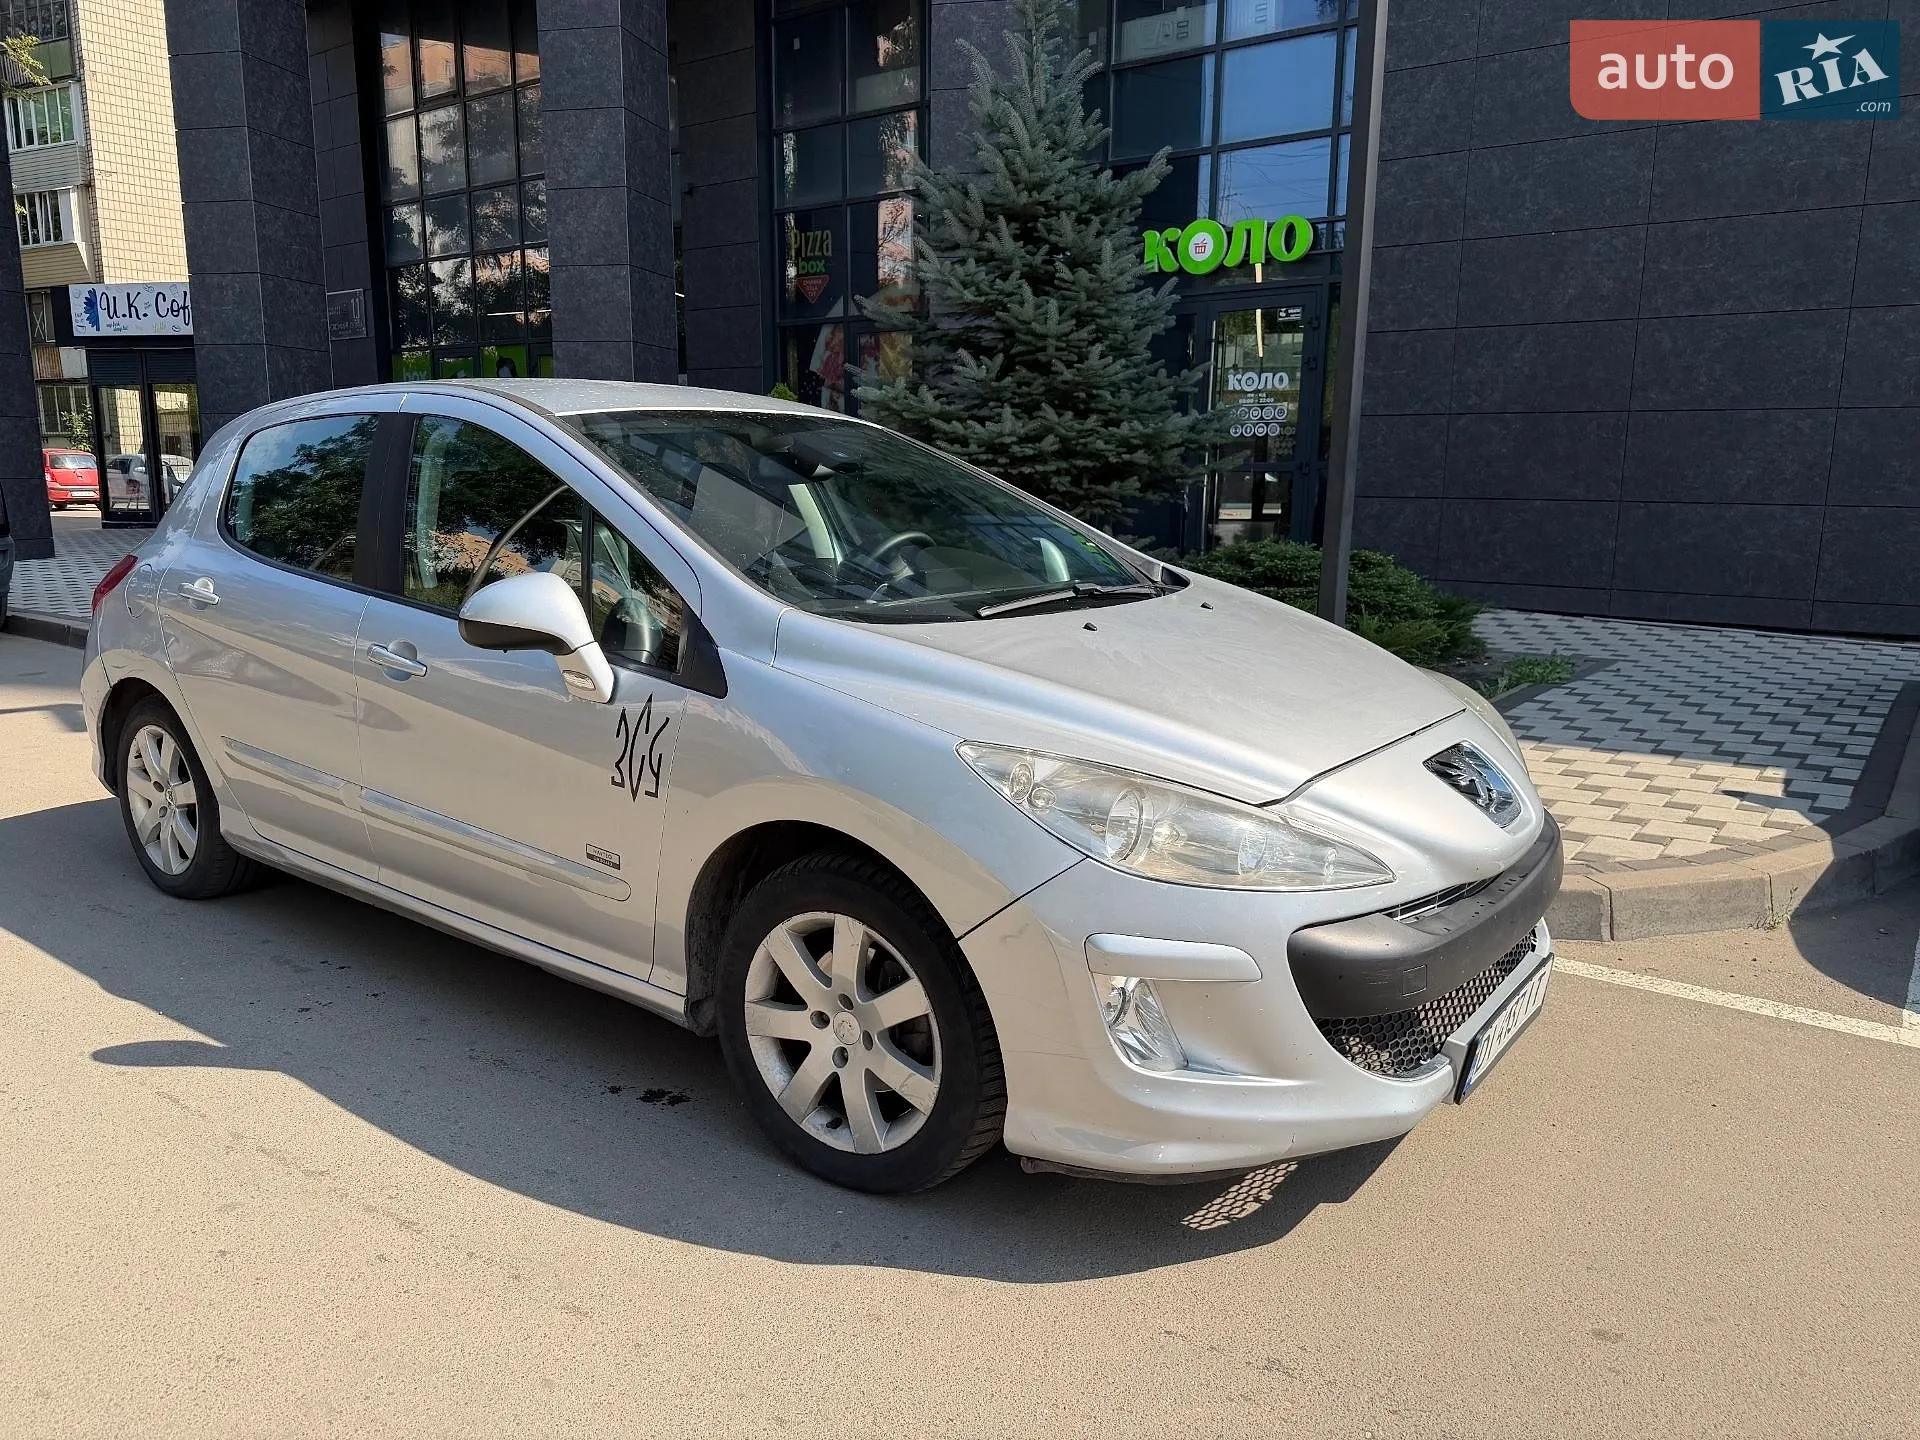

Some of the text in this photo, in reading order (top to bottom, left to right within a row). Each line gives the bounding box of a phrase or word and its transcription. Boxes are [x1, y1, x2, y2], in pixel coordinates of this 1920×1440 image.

[1142, 214, 1314, 275] КОЛО
[799, 257, 826, 274] box
[1228, 371, 1289, 392] КОЛО
